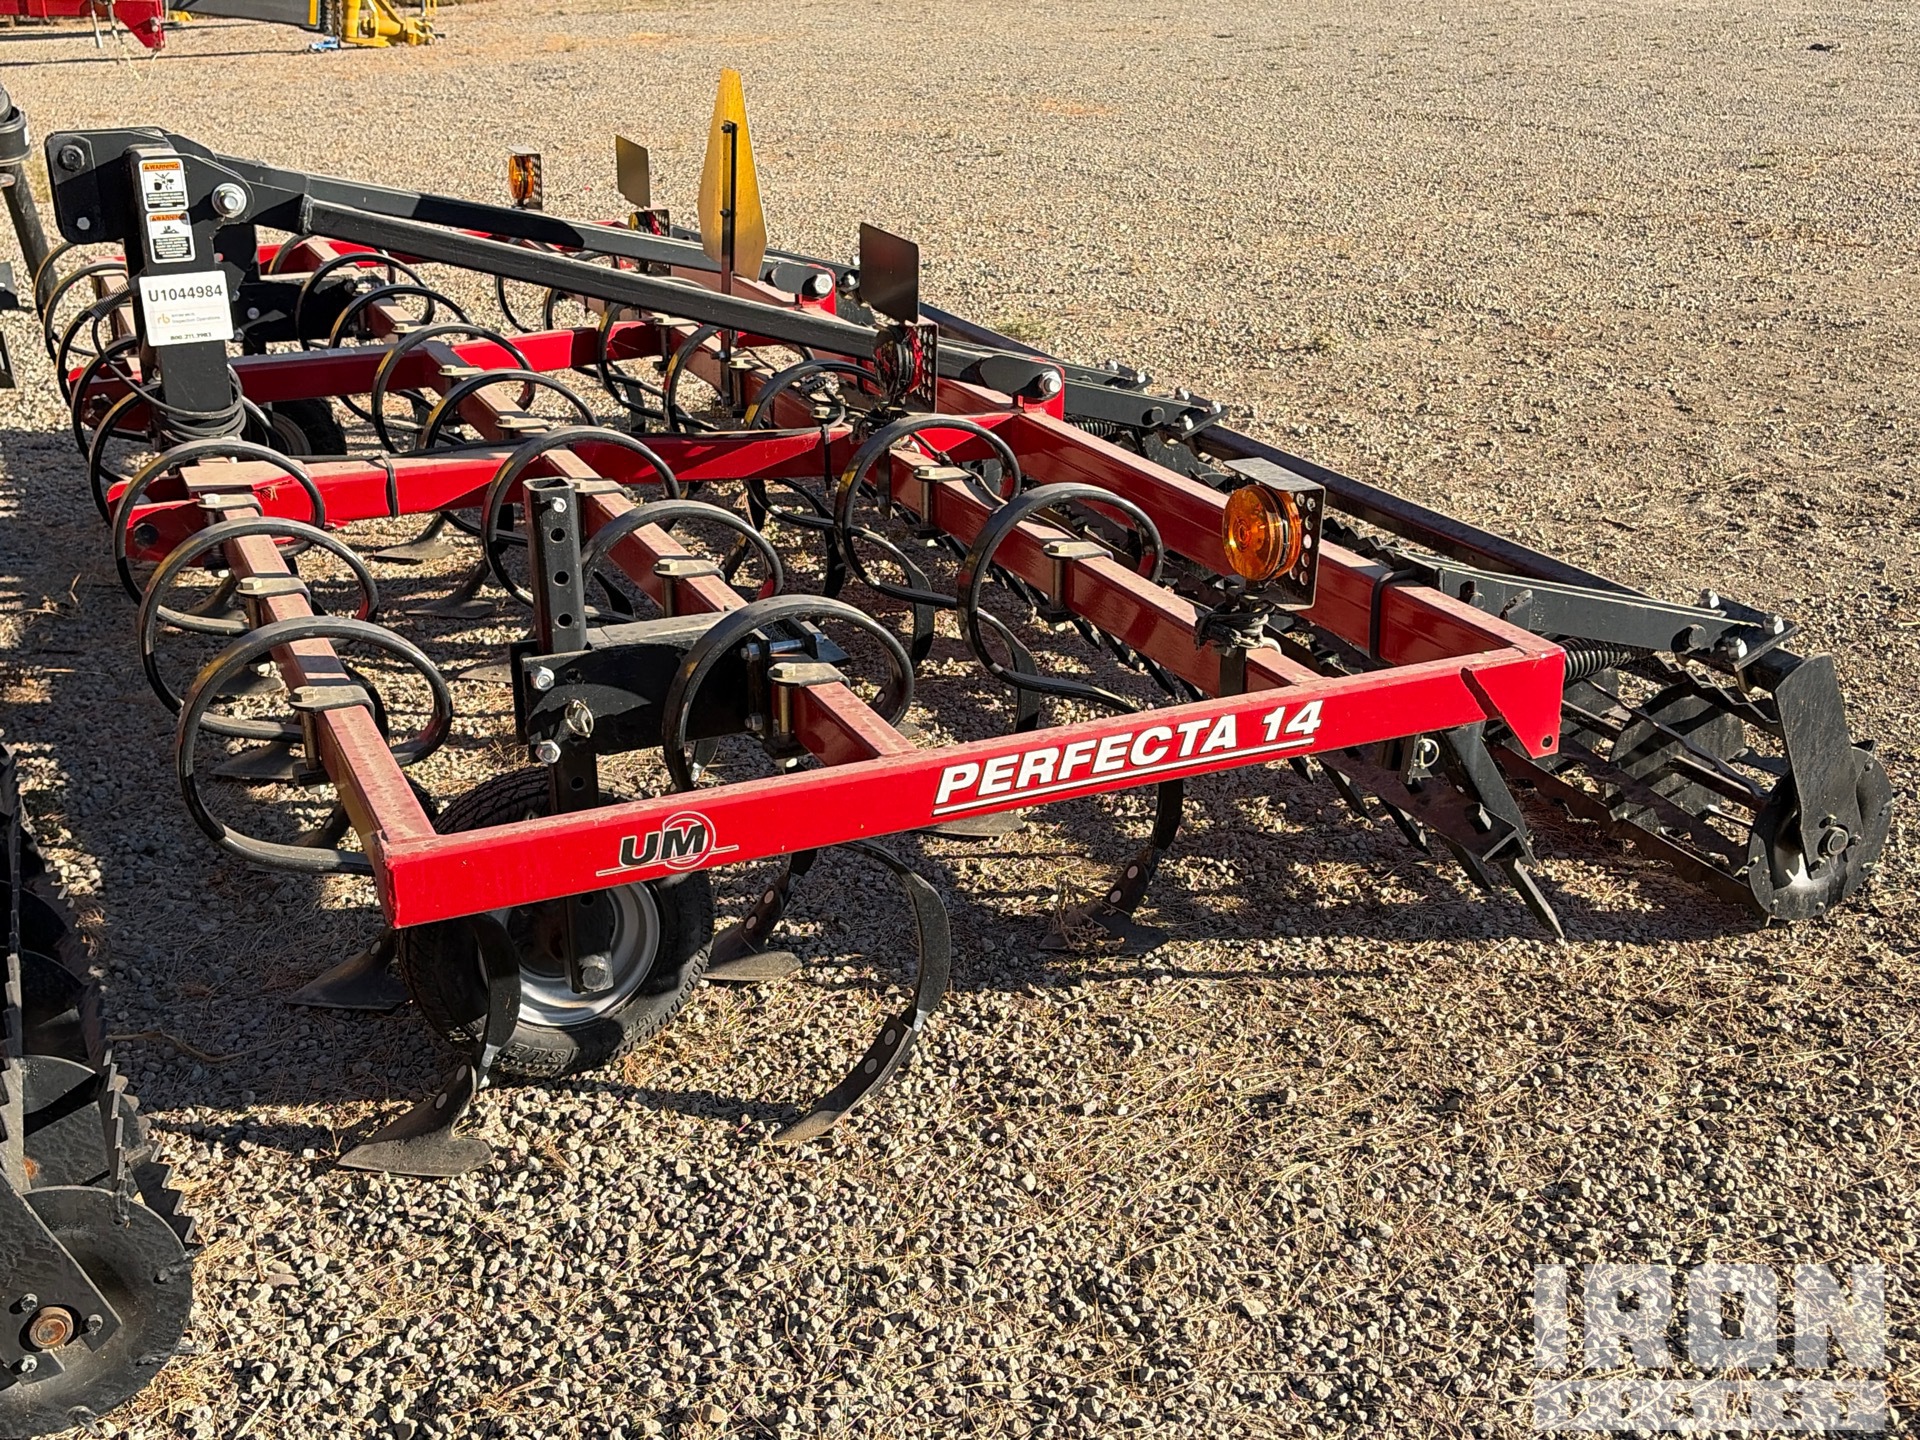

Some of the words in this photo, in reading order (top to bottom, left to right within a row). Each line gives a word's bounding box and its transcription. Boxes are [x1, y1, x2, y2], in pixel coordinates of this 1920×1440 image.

[148, 284, 223, 302] U1044984
[935, 714, 1237, 804] PERFECTA
[1262, 700, 1323, 742] 14
[620, 823, 706, 867] UM
